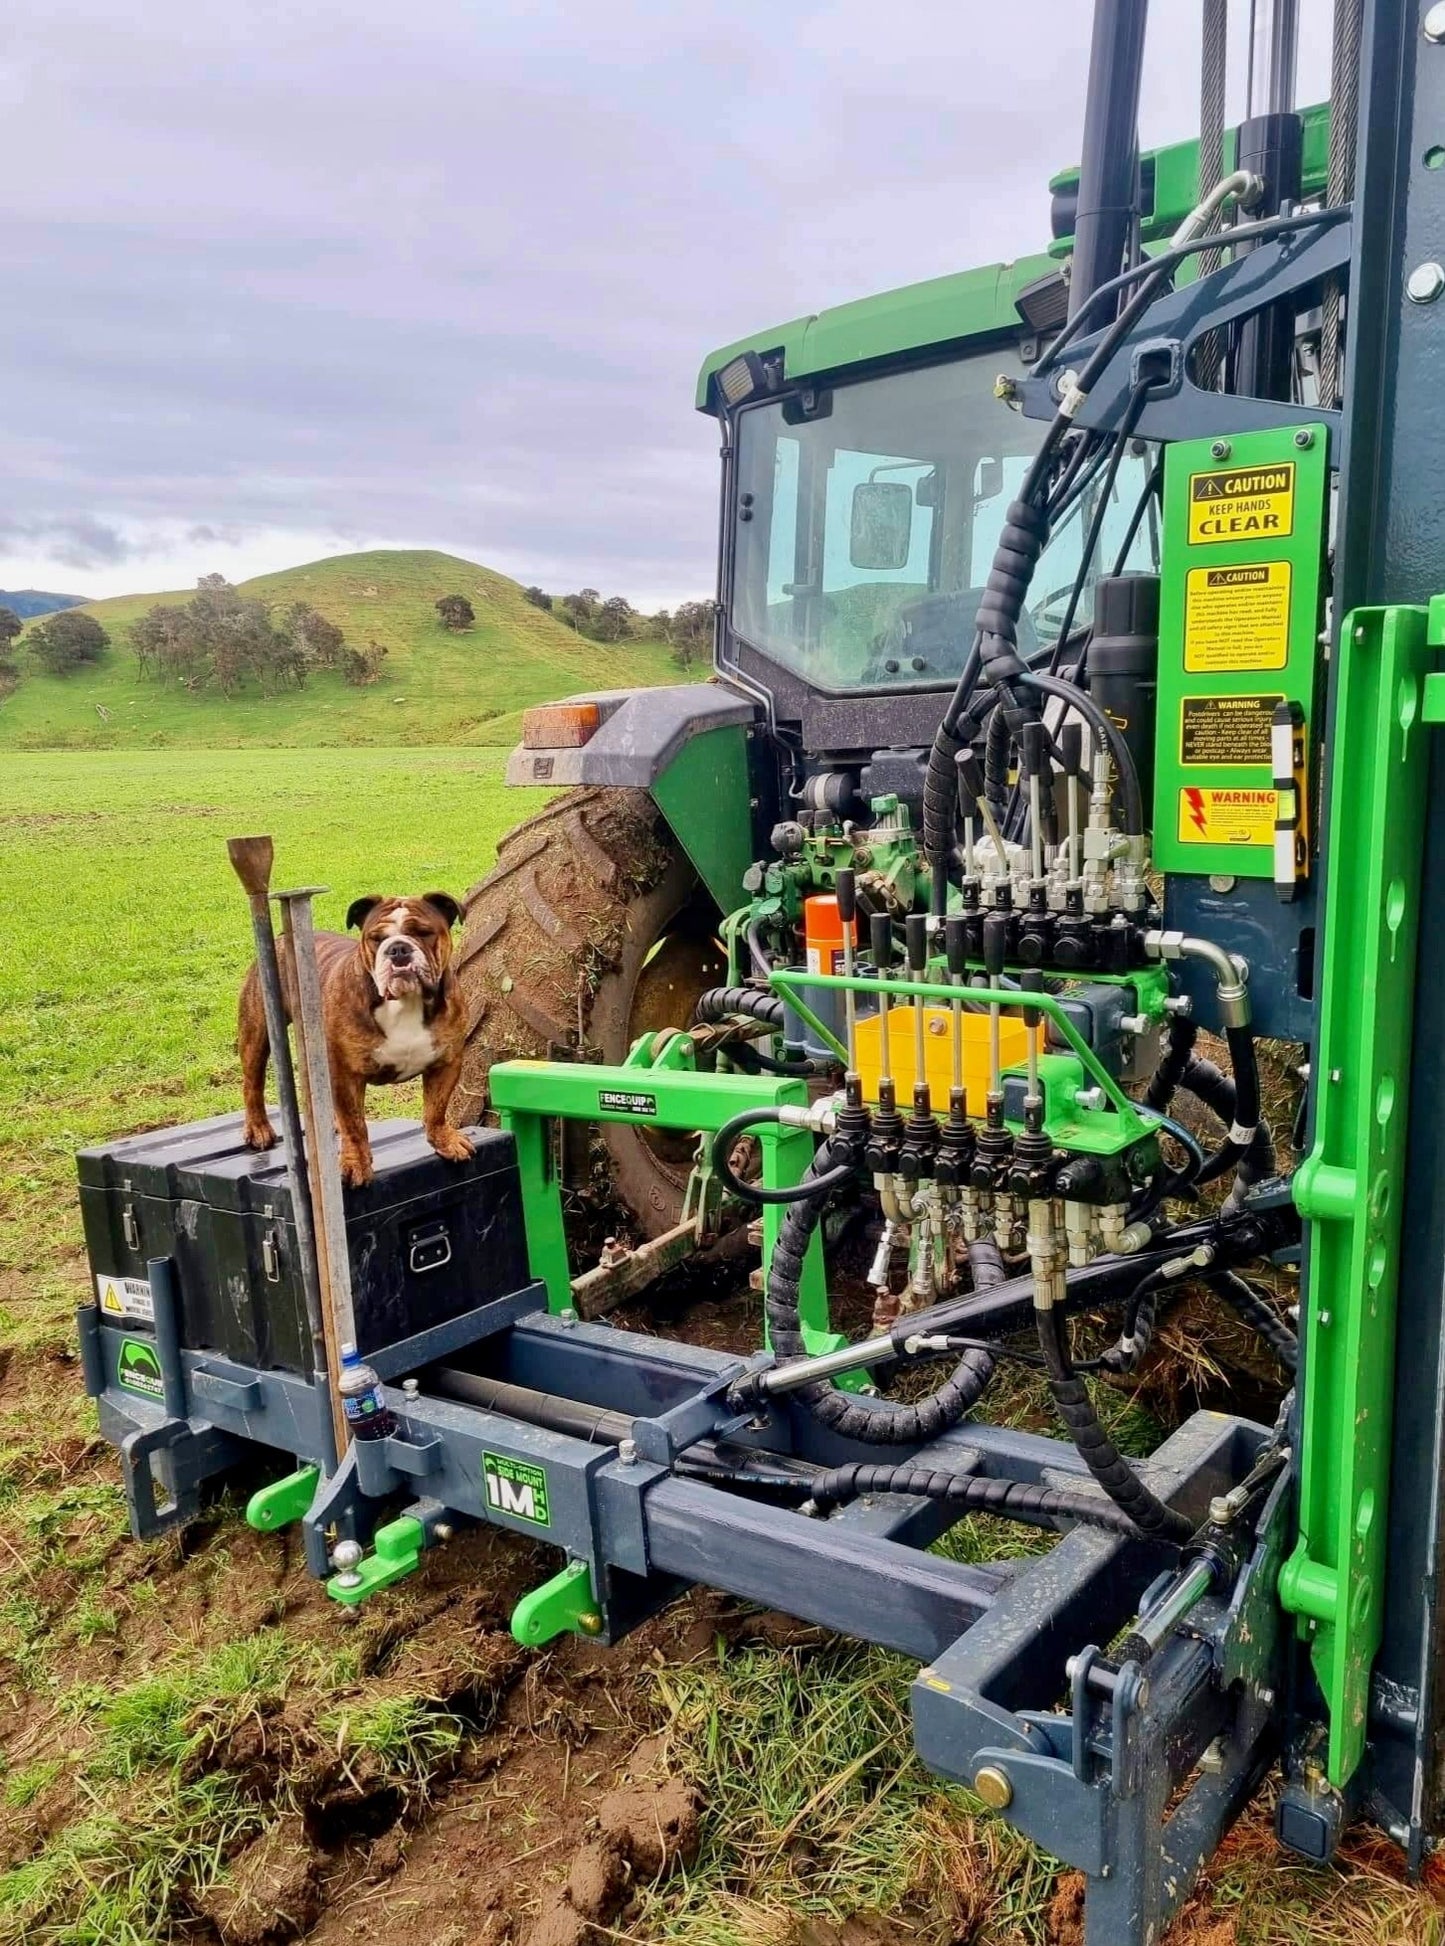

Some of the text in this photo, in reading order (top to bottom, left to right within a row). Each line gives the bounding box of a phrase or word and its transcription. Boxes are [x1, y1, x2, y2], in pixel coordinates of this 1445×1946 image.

[1225, 473, 1286, 494] CAUTION
[1209, 499, 1271, 516] KEEP HANDS
[1199, 514, 1280, 535] CLEAR
[1227, 571, 1265, 583] CAUTION
[1218, 701, 1260, 709] WARNING
[1211, 792, 1275, 803] WARNING
[600, 1093, 647, 1106] FENCEQUIP
[124, 1282, 151, 1296] WARNIN
[496, 1458, 542, 1476] MULTI-OPTION
[497, 1465, 543, 1488] SIDE MOUNT
[487, 1473, 535, 1519] 1M
